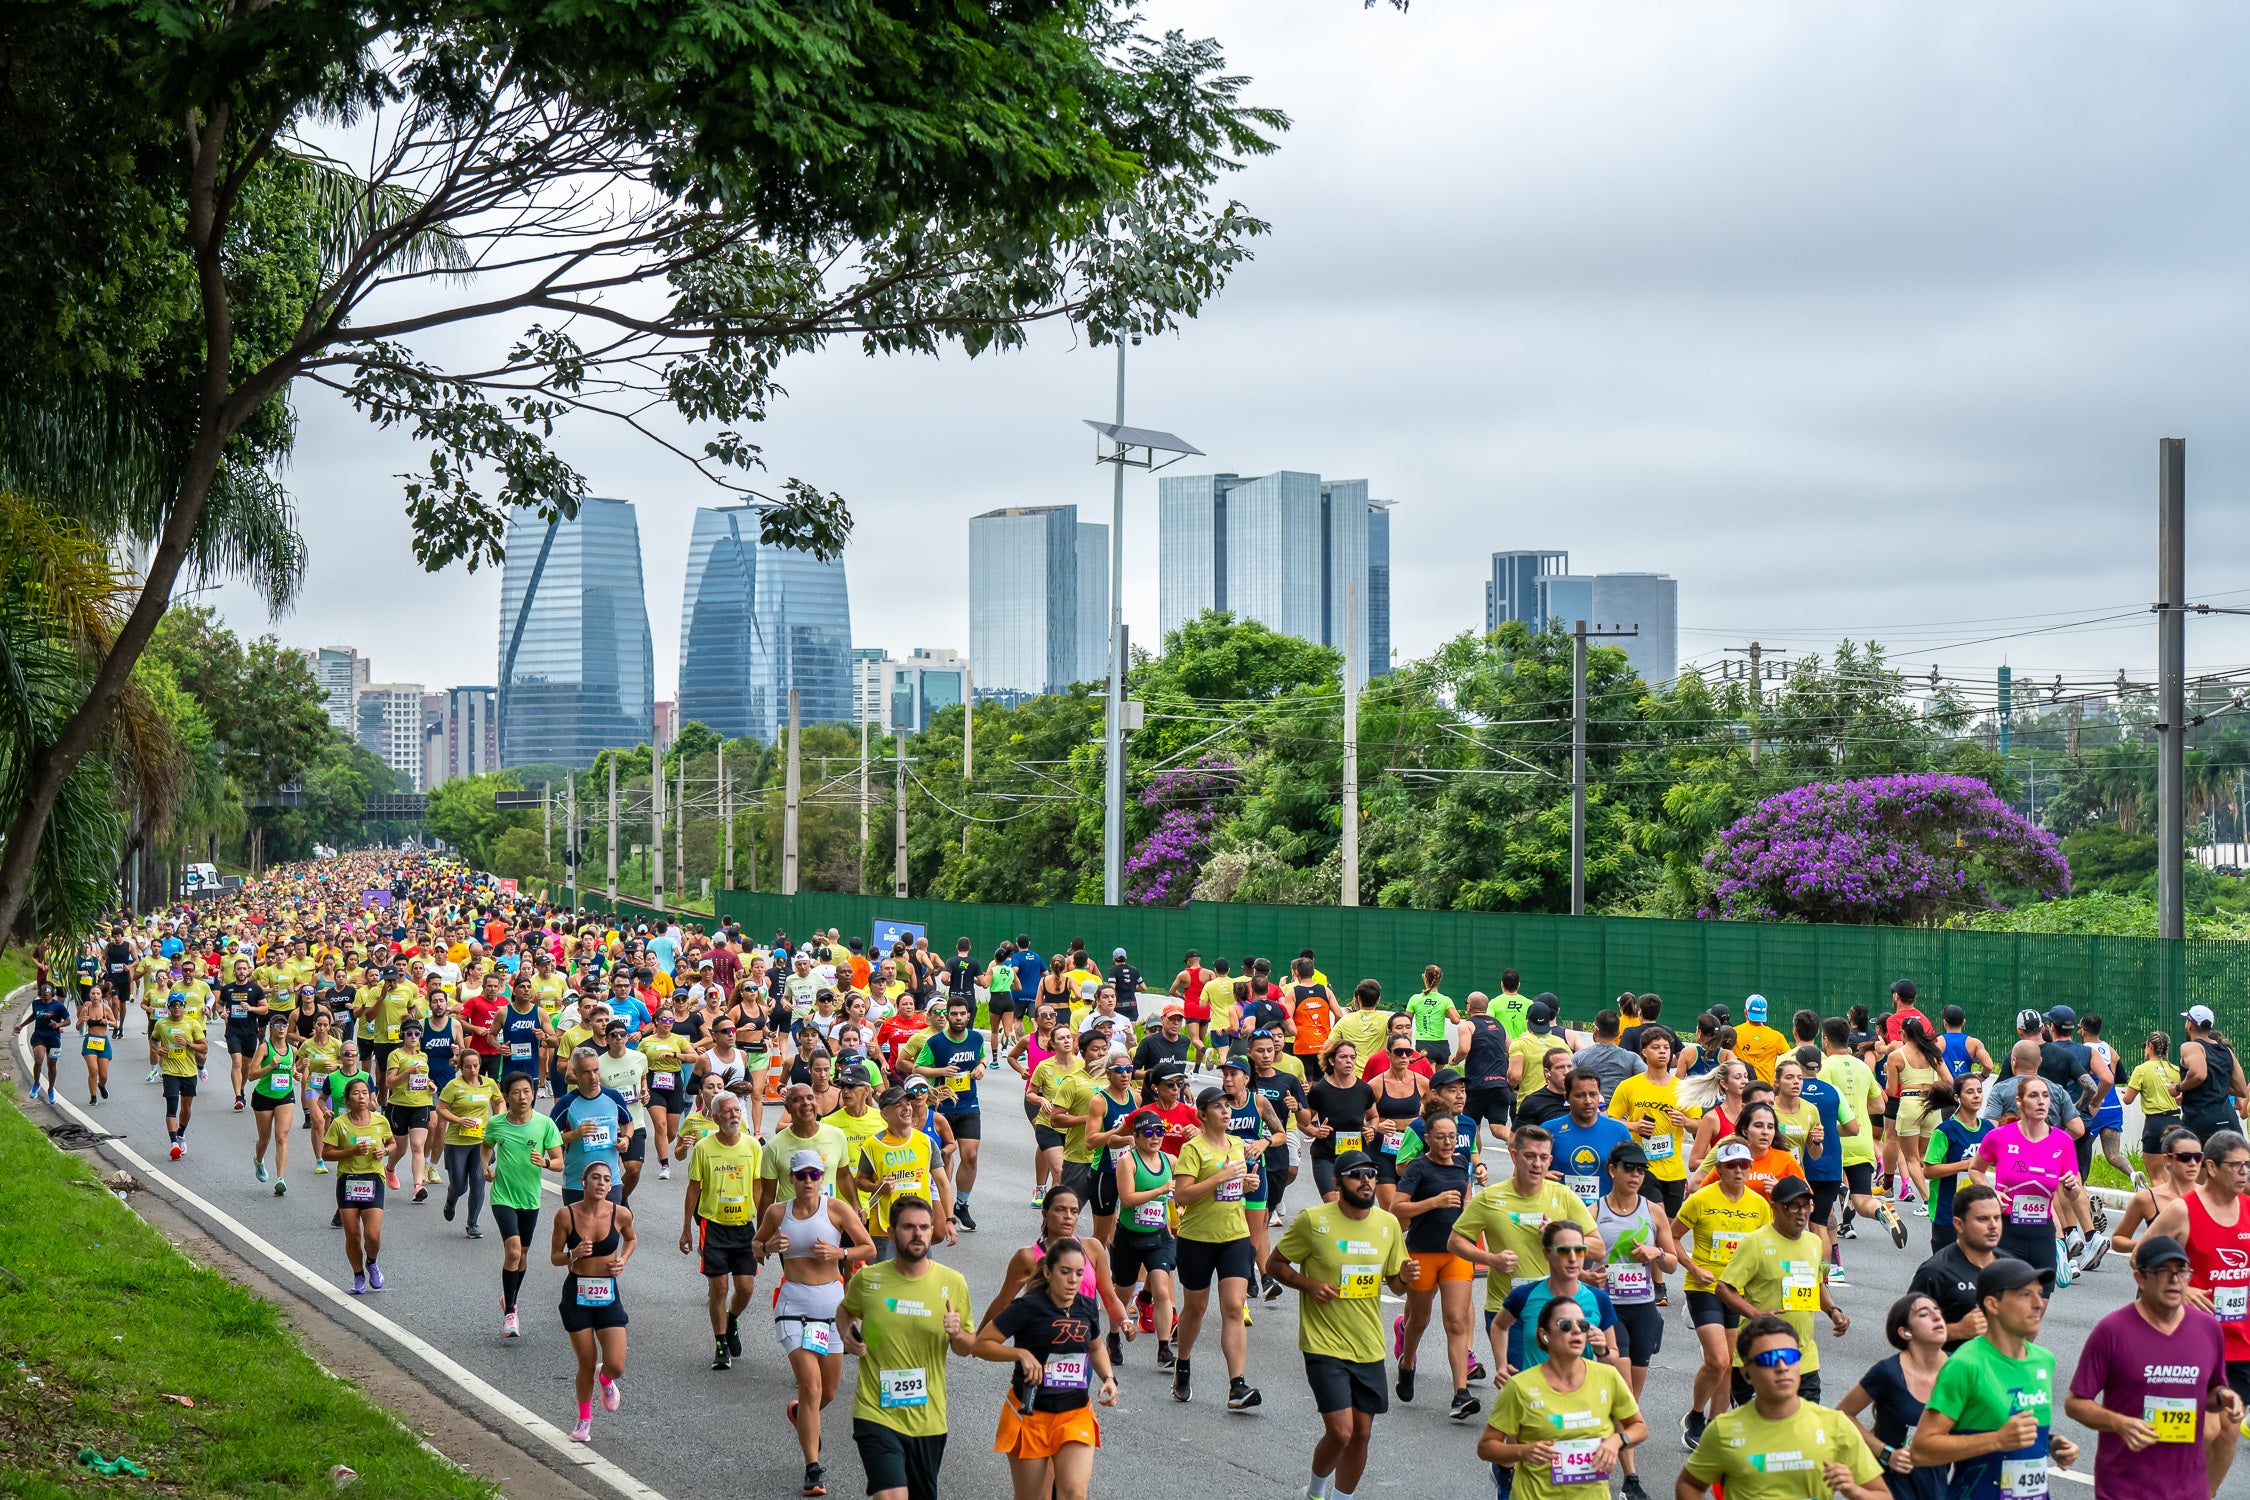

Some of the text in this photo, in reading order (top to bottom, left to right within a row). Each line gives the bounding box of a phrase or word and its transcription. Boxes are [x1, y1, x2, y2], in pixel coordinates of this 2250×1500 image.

[426, 1038, 450, 1048] AZON
[948, 1051, 974, 1064] AZON
[592, 1133, 608, 1142] 3102
[1652, 1142, 1669, 1151] 2887
[885, 1148, 918, 1166] GUIA
[1226, 1182, 1240, 1191] 4991
[1574, 1184, 1596, 1194] 2672
[724, 1206, 742, 1214] GUIA
[1144, 1208, 1162, 1217] 4947
[2022, 1202, 2044, 1212] 4665
[1357, 1275, 1374, 1286] 656
[1618, 1272, 1643, 1283] 4663
[588, 1286, 609, 1295] 2376
[1797, 1288, 1812, 1298] 673
[2226, 1296, 2244, 1308] 4853
[1056, 1362, 1080, 1374] 5703
[2143, 1364, 2200, 1377] SANDRO
[895, 1380, 923, 1392] 2593
[2146, 1376, 2196, 1385] PERFORMANCE
[2162, 1412, 2190, 1424] 1792
[1766, 1450, 1802, 1462] ATHENAS
[1766, 1459, 1814, 1472] RUN FASTER
[2018, 1471, 2046, 1487] 4306
